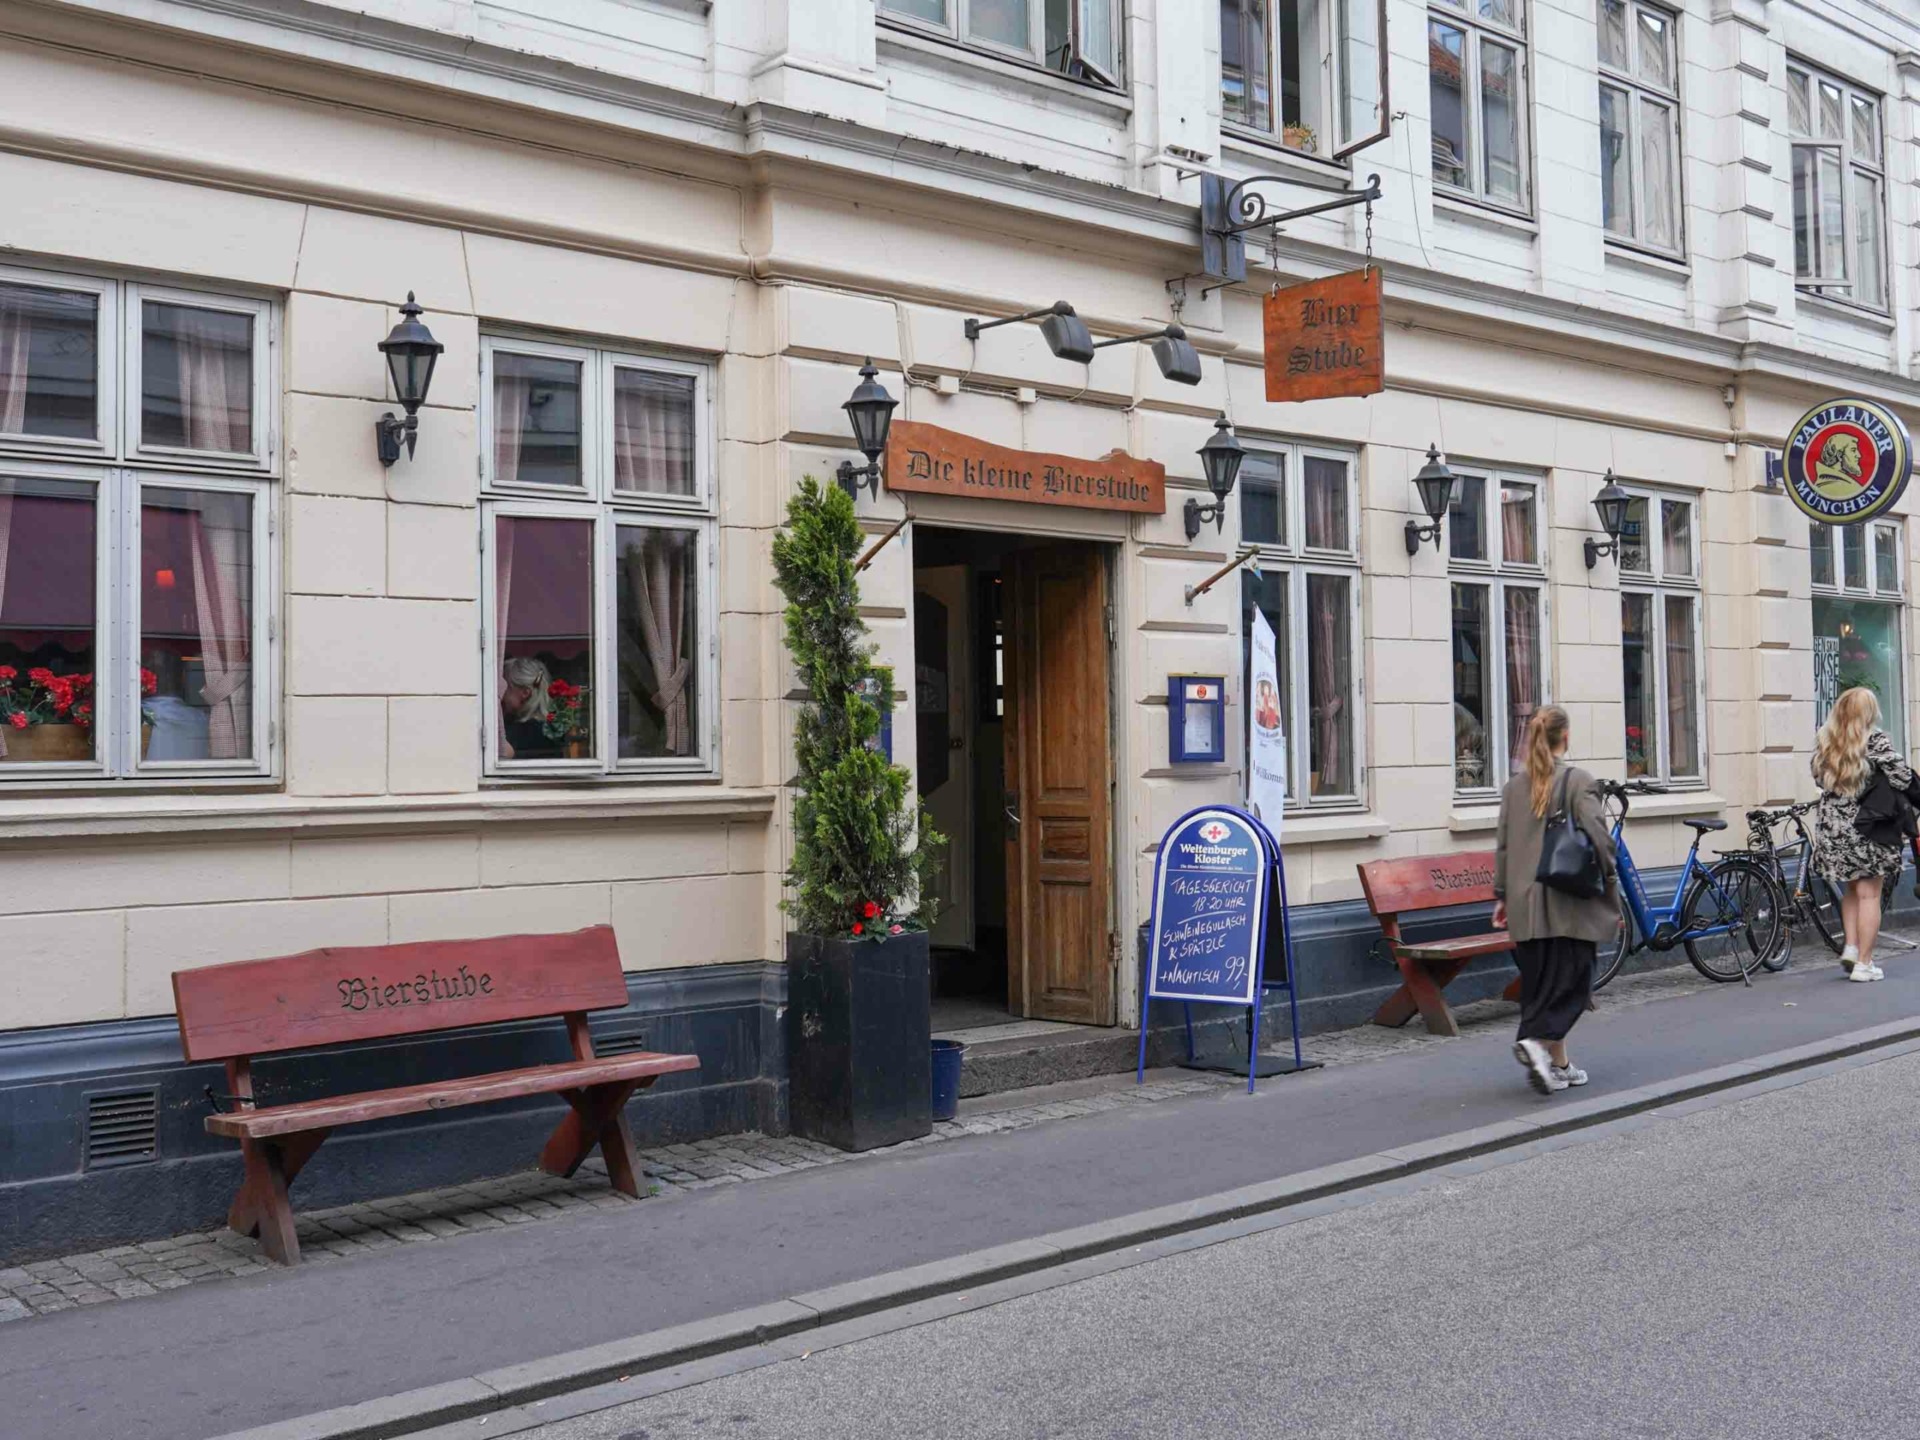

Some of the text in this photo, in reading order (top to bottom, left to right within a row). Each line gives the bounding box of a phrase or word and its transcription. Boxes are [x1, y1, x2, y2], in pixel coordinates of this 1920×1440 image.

[1301, 298, 1361, 330] Bier
[1287, 341, 1365, 377] Stube
[1793, 406, 1893, 455] PAULANER
[907, 448, 1150, 503] Die kleine Bierstube
[1795, 479, 1881, 515] MÜNCHEN
[1179, 843, 1249, 857] Weltenburger
[1194, 854, 1232, 865] Kloster
[1430, 864, 1495, 890] Bierstub
[1192, 896, 1246, 912] 18-20 UHR
[337, 964, 495, 1011] Bierstube
